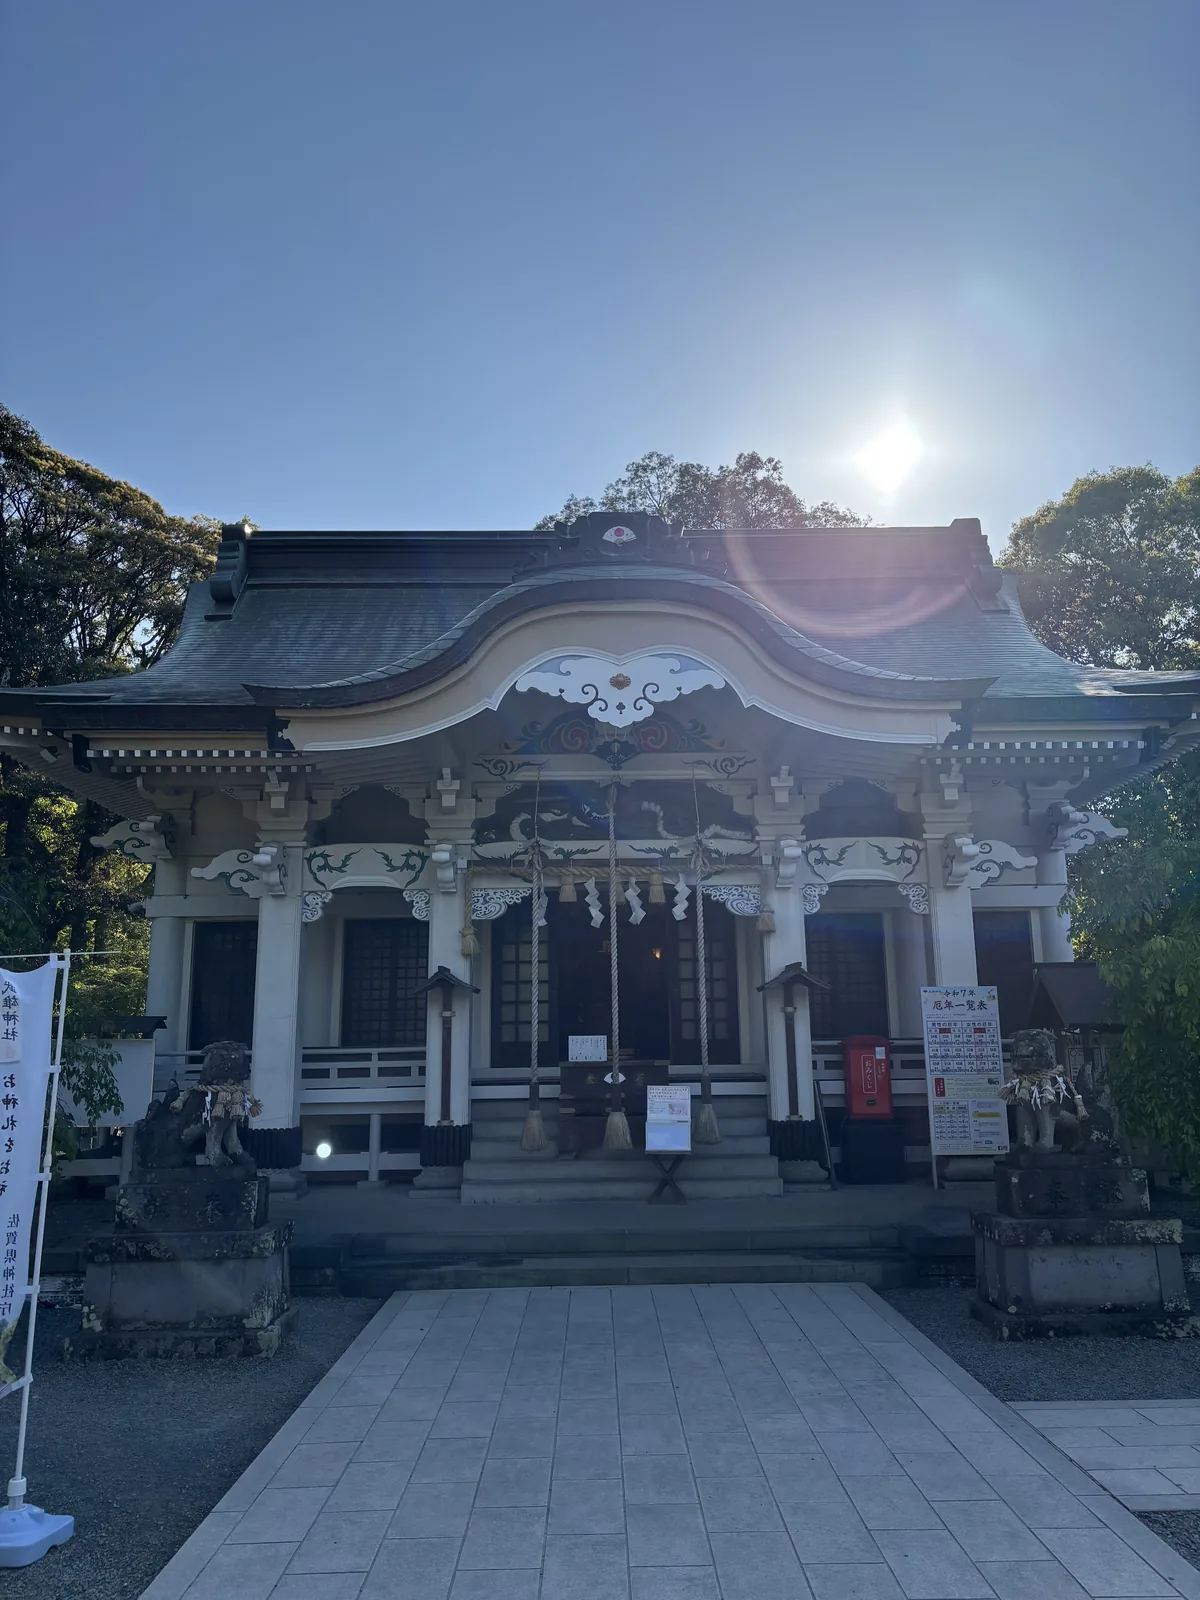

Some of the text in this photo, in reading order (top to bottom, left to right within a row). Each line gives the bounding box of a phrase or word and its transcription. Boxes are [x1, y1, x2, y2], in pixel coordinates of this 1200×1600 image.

[944, 989, 976, 997] 令和7年
[933, 1000, 988, 1011] 厄年一覧表
